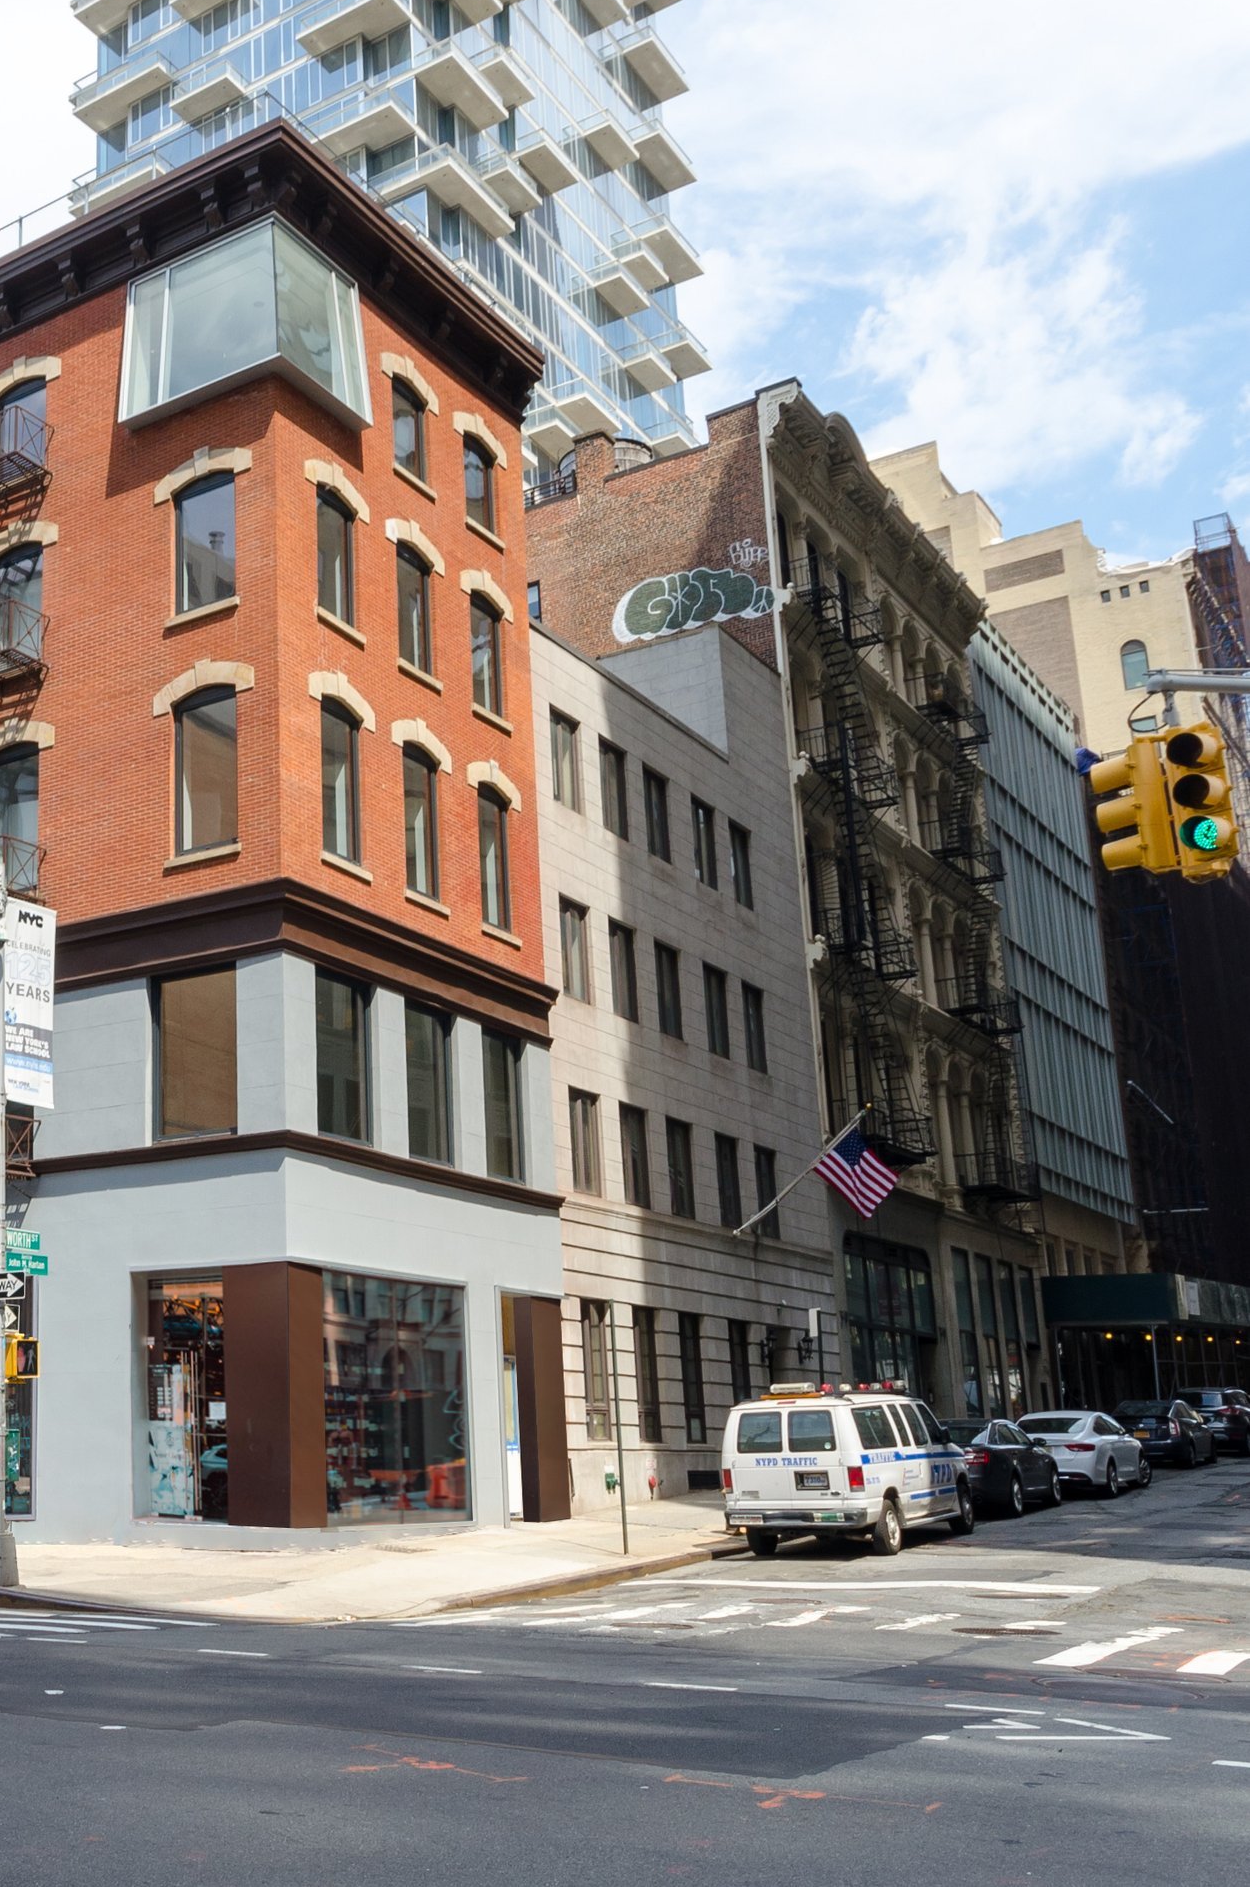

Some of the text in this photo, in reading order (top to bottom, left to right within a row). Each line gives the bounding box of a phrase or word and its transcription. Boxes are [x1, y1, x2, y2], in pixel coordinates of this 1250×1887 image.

[18, 910, 43, 928] NYC
[6, 940, 51, 957] CELEBRATING
[5, 952, 51, 987] 125
[6, 981, 50, 1003] YEARS
[5, 1024, 33, 1038] WE ARE
[6, 1033, 49, 1050] NEW YORK'S
[5, 1043, 50, 1058] LAW SCHOOL
[6, 1231, 38, 1248] WORTH ST
[755, 1457, 818, 1466] NYPD TRAFFIC
[870, 1453, 896, 1462] TRAFFIC
